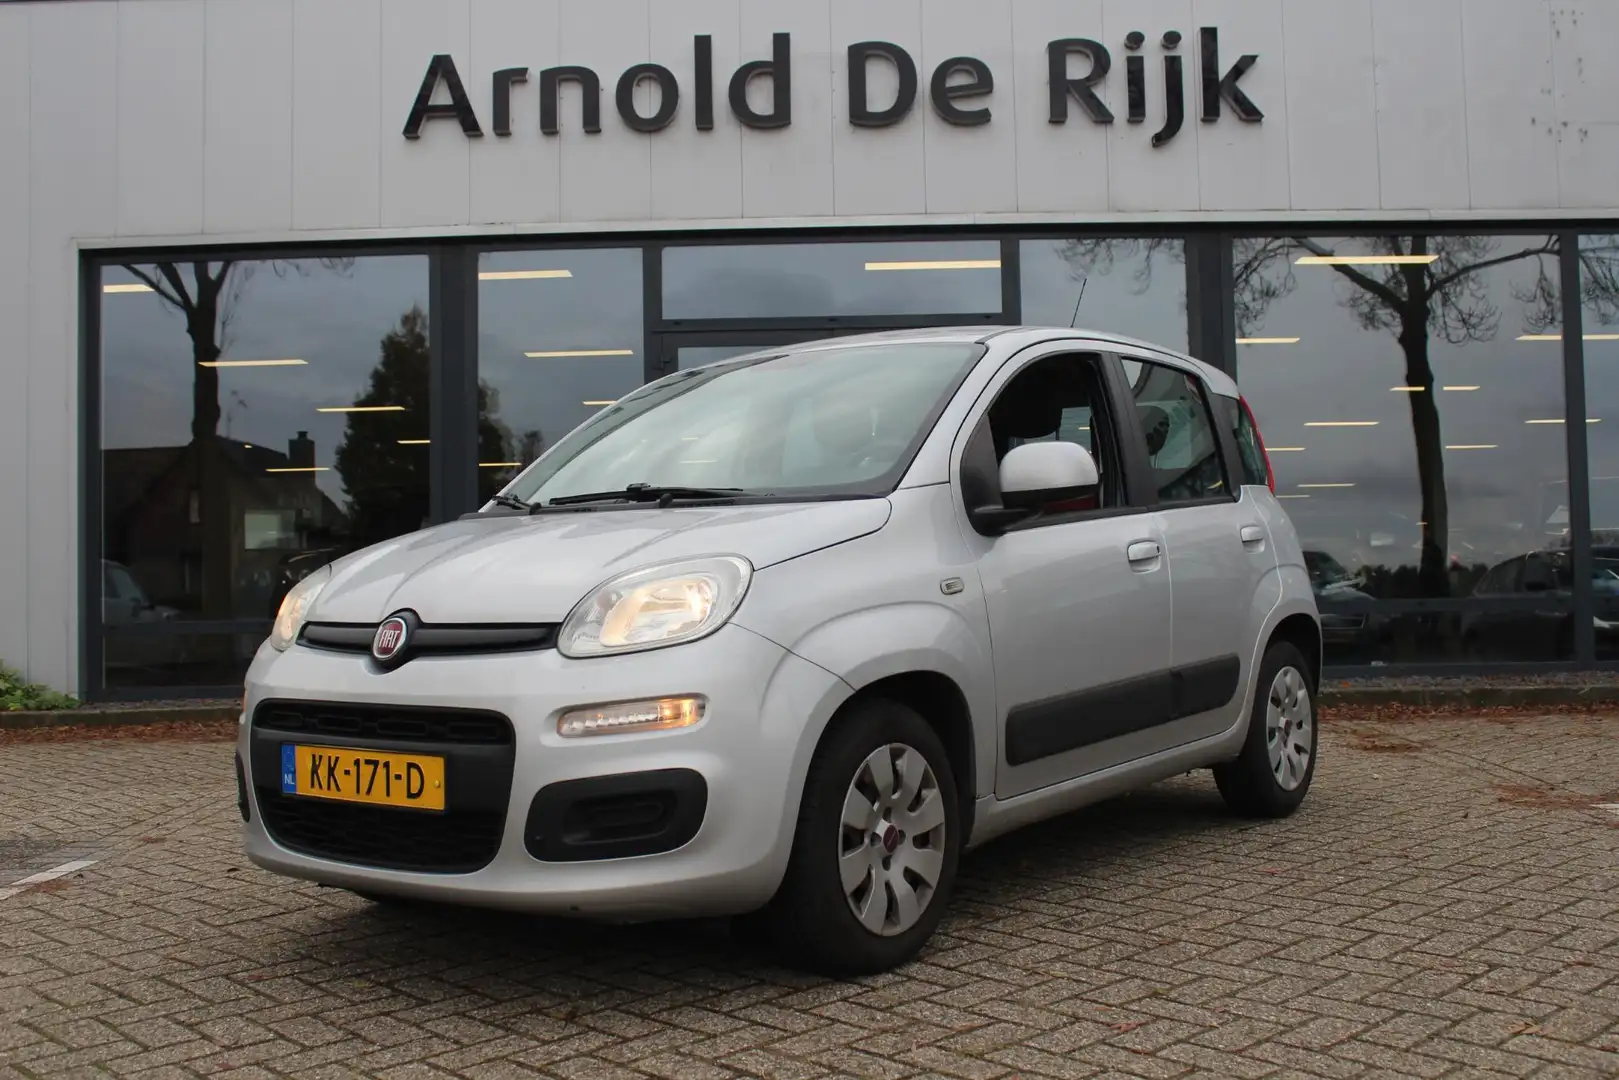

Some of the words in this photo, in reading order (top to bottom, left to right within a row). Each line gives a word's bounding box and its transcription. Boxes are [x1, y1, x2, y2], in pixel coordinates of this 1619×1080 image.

[402, 32, 791, 139] Arnold
[847, 40, 994, 129] De
[1046, 27, 1264, 148] Rijk
[378, 629, 401, 649] FIAT
[284, 773, 295, 785] NL
[310, 753, 425, 799] KK-171-D
